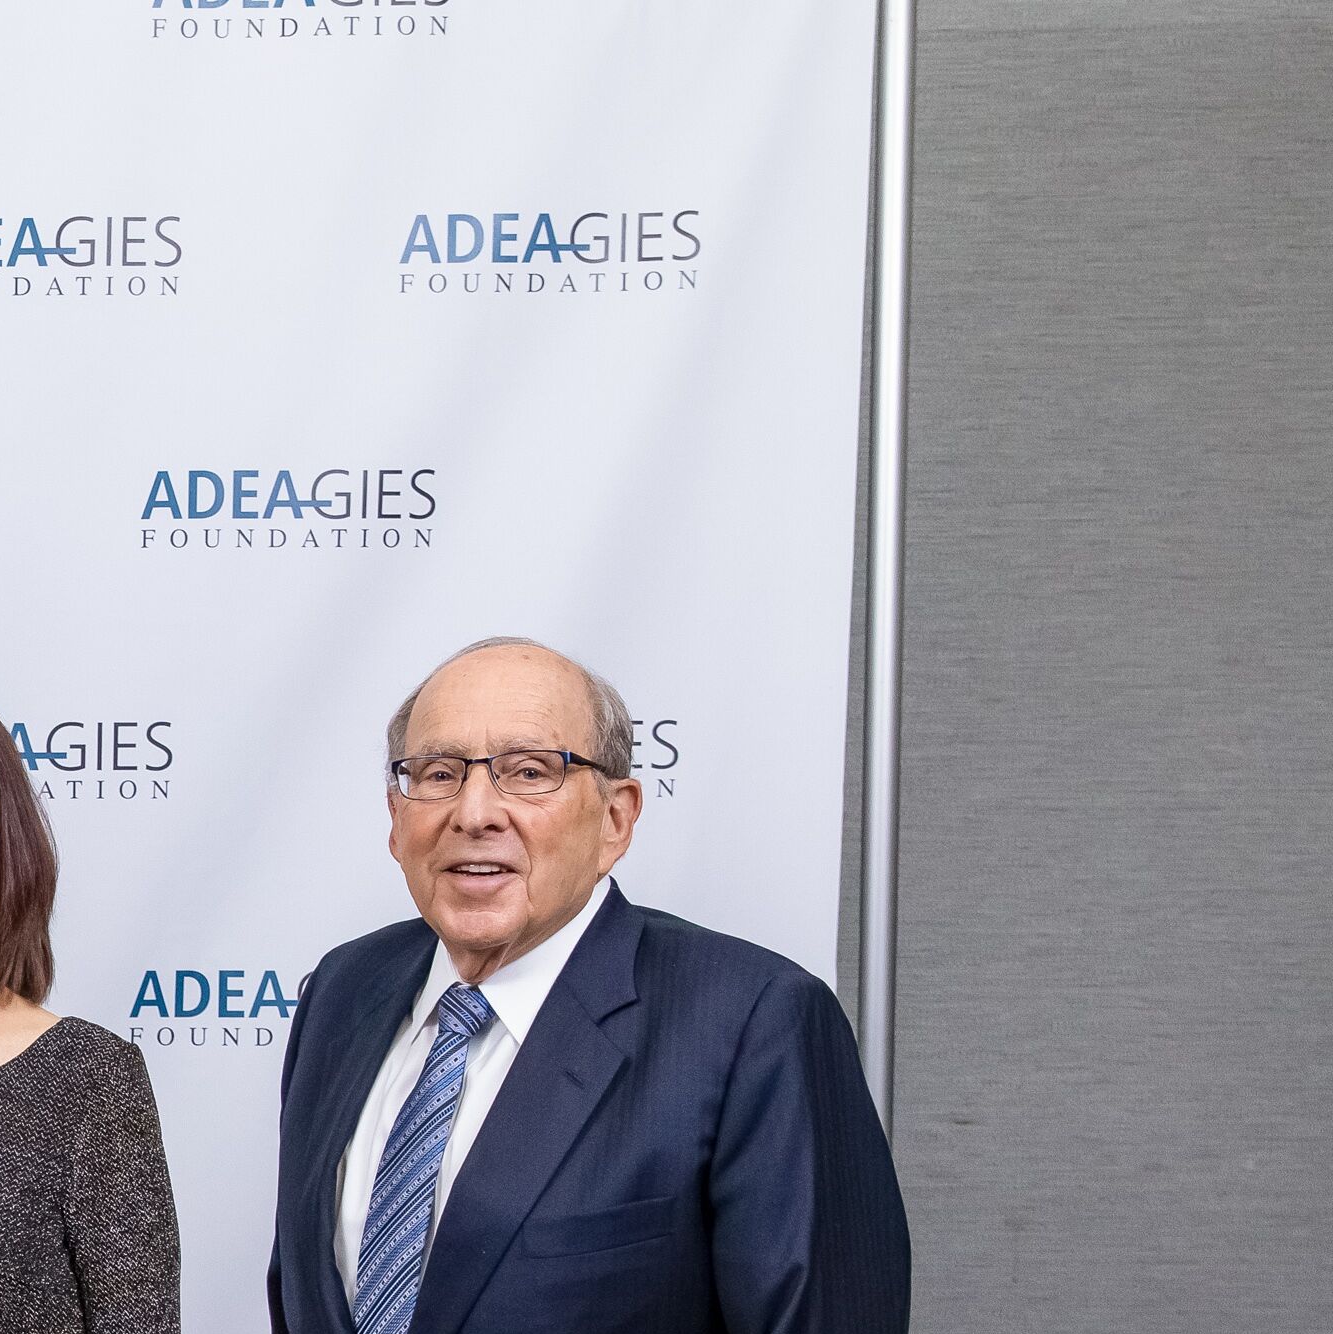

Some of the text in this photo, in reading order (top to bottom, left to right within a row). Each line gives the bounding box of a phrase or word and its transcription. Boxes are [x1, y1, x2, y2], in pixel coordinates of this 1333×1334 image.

[152, 16, 448, 38] FOUNDATION
[400, 270, 697, 293] FOUNDATION
[141, 529, 433, 548] FOUNDATION
[38, 779, 171, 799] ATION
[130, 1027, 273, 1046] FOUND
